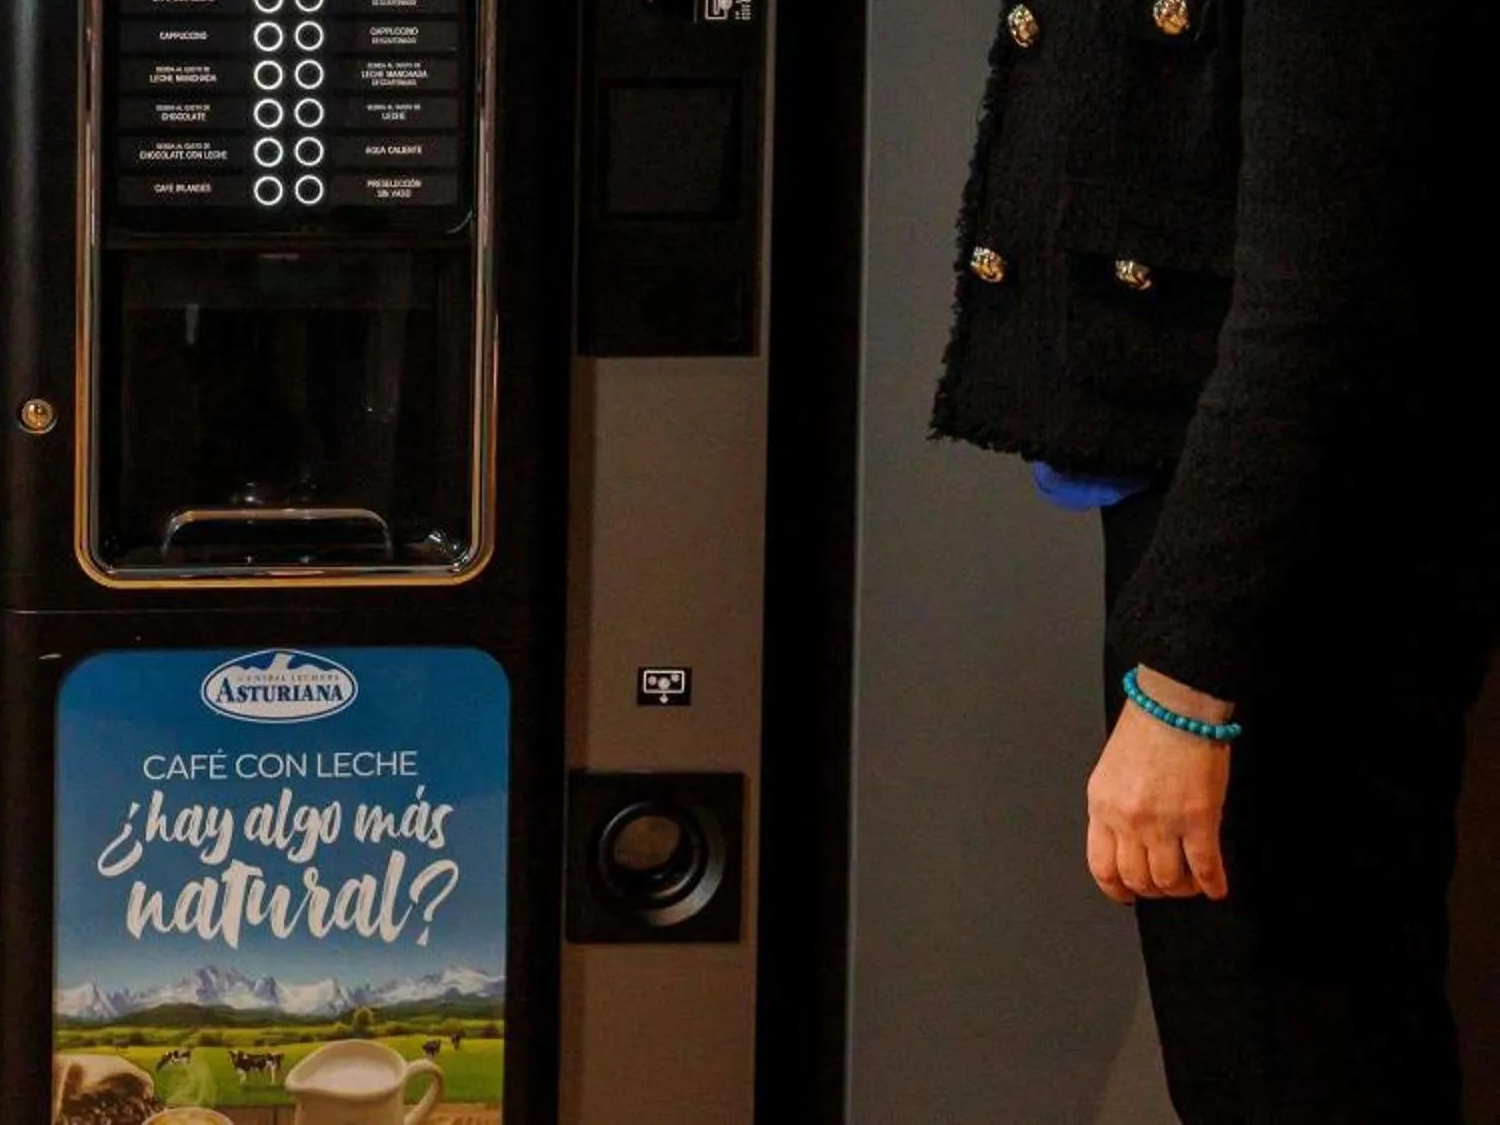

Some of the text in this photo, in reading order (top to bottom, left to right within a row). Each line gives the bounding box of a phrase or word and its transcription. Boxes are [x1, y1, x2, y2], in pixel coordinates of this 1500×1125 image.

[215, 677, 345, 705] ASTURIANA
[143, 749, 418, 780] CAFÉ CON LECHE
[97, 784, 454, 877] ¿hay algo más
[125, 849, 460, 950] natural?
